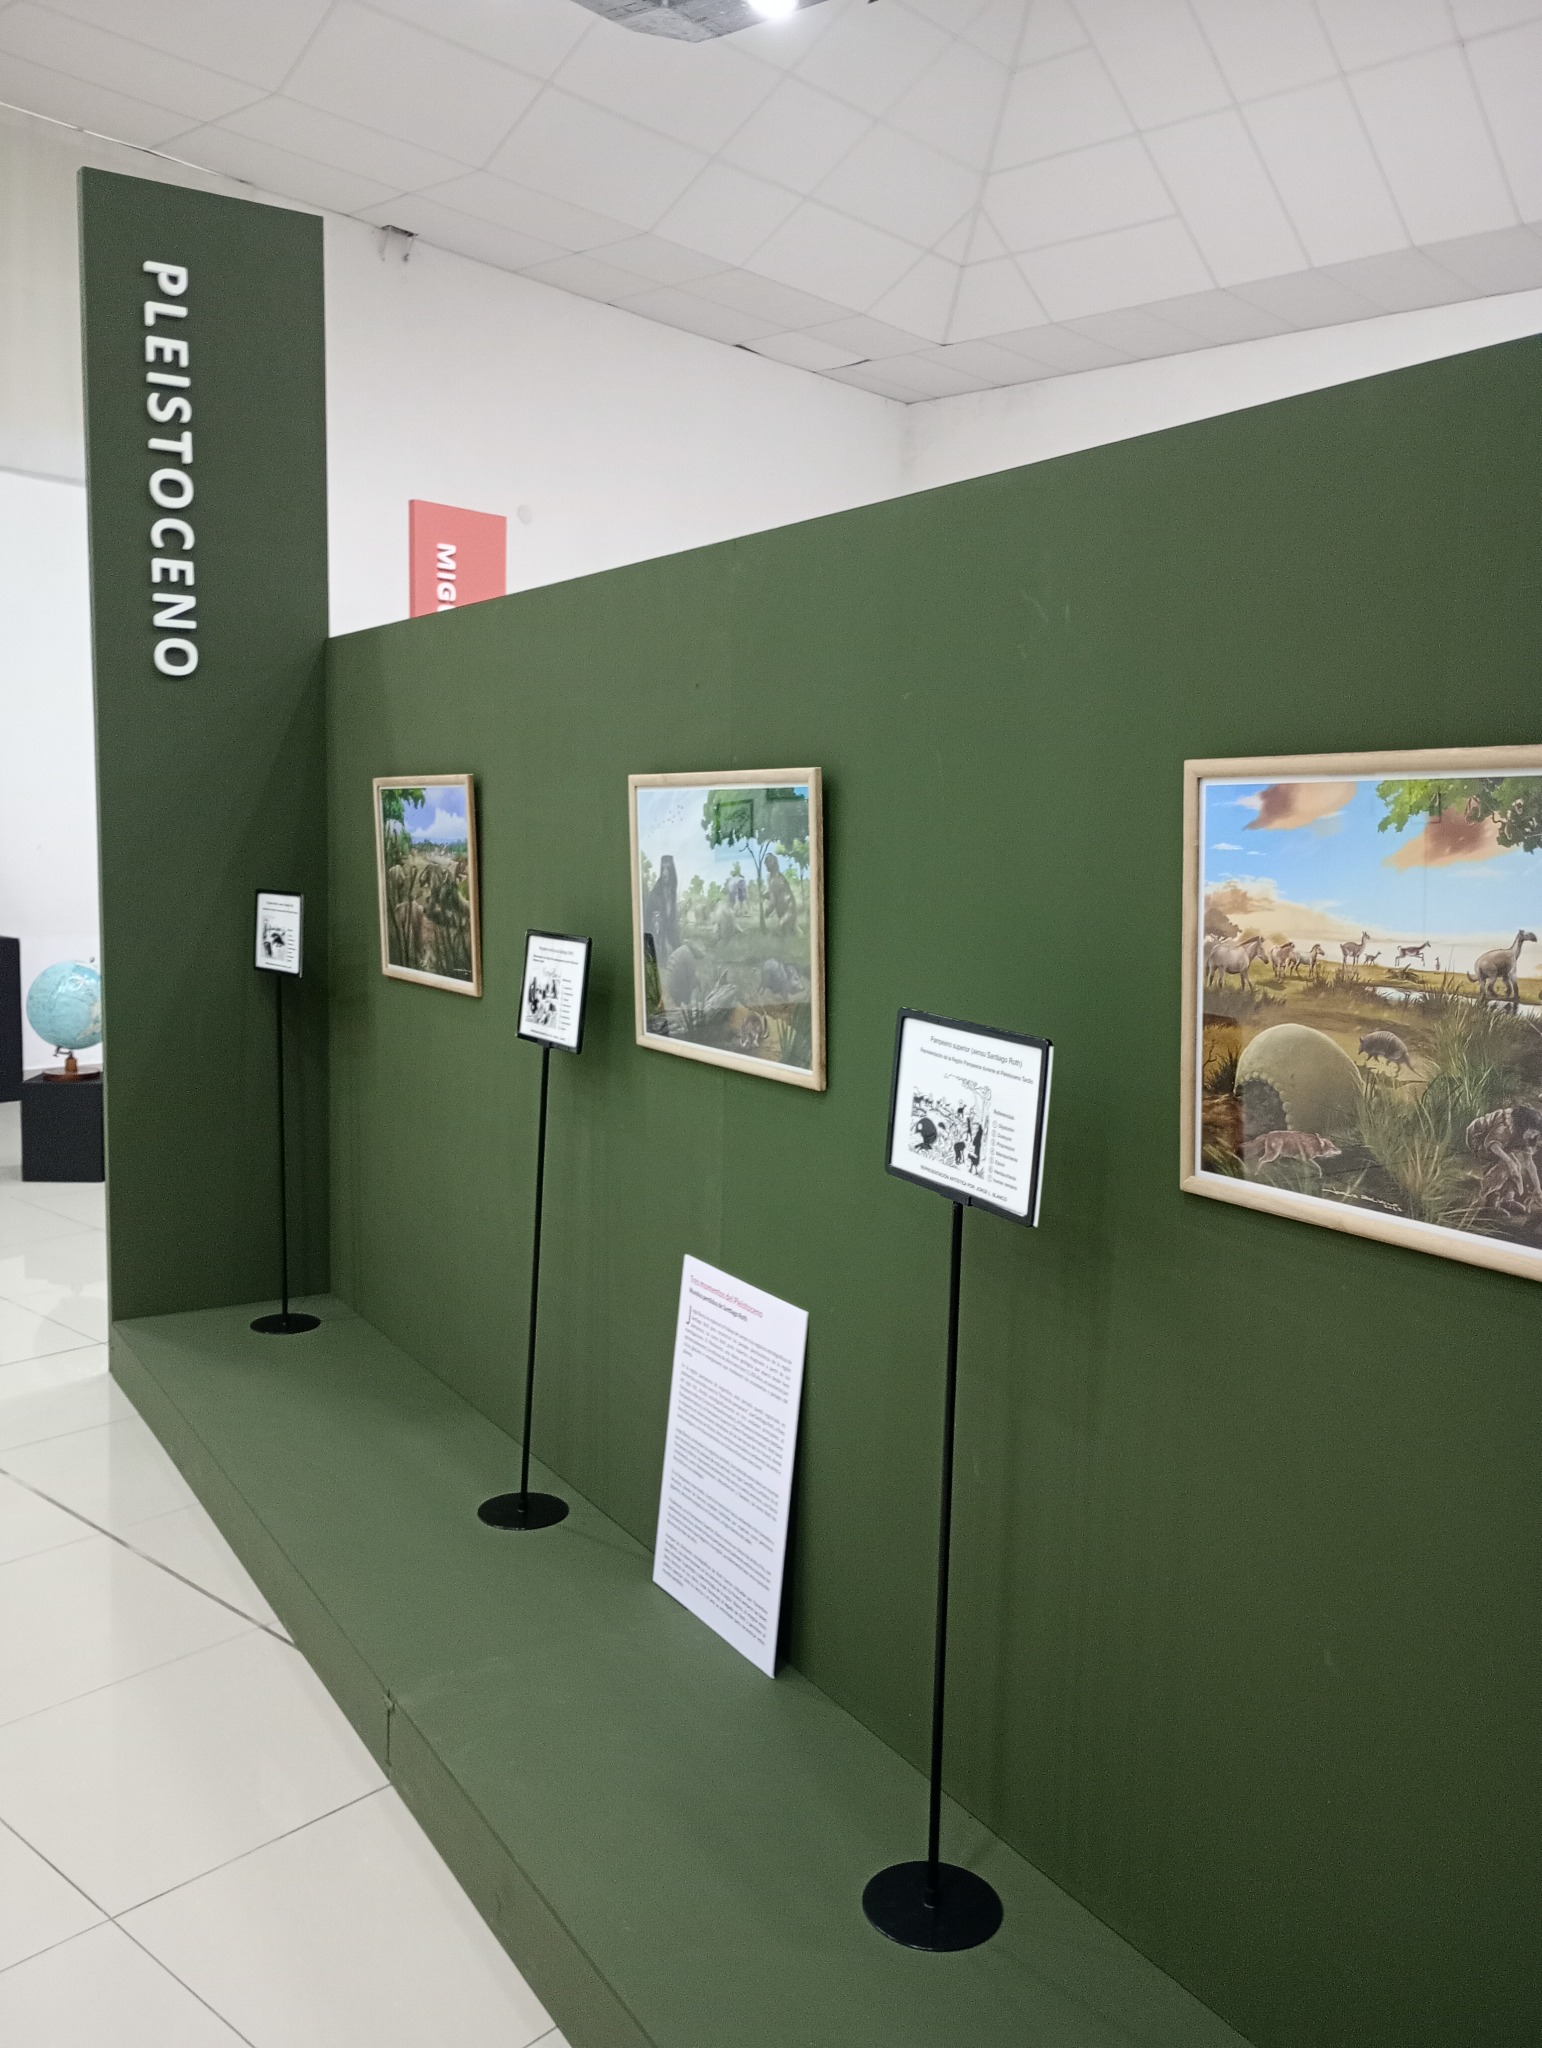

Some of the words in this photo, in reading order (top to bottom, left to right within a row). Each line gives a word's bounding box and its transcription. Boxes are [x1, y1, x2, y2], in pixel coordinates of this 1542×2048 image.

[142, 260, 199, 677] PLEISTOCENO
[952, 1042, 970, 1053] superior
[987, 1051, 1008, 1064] Santiago
[1008, 1056, 1023, 1068] Roth)
